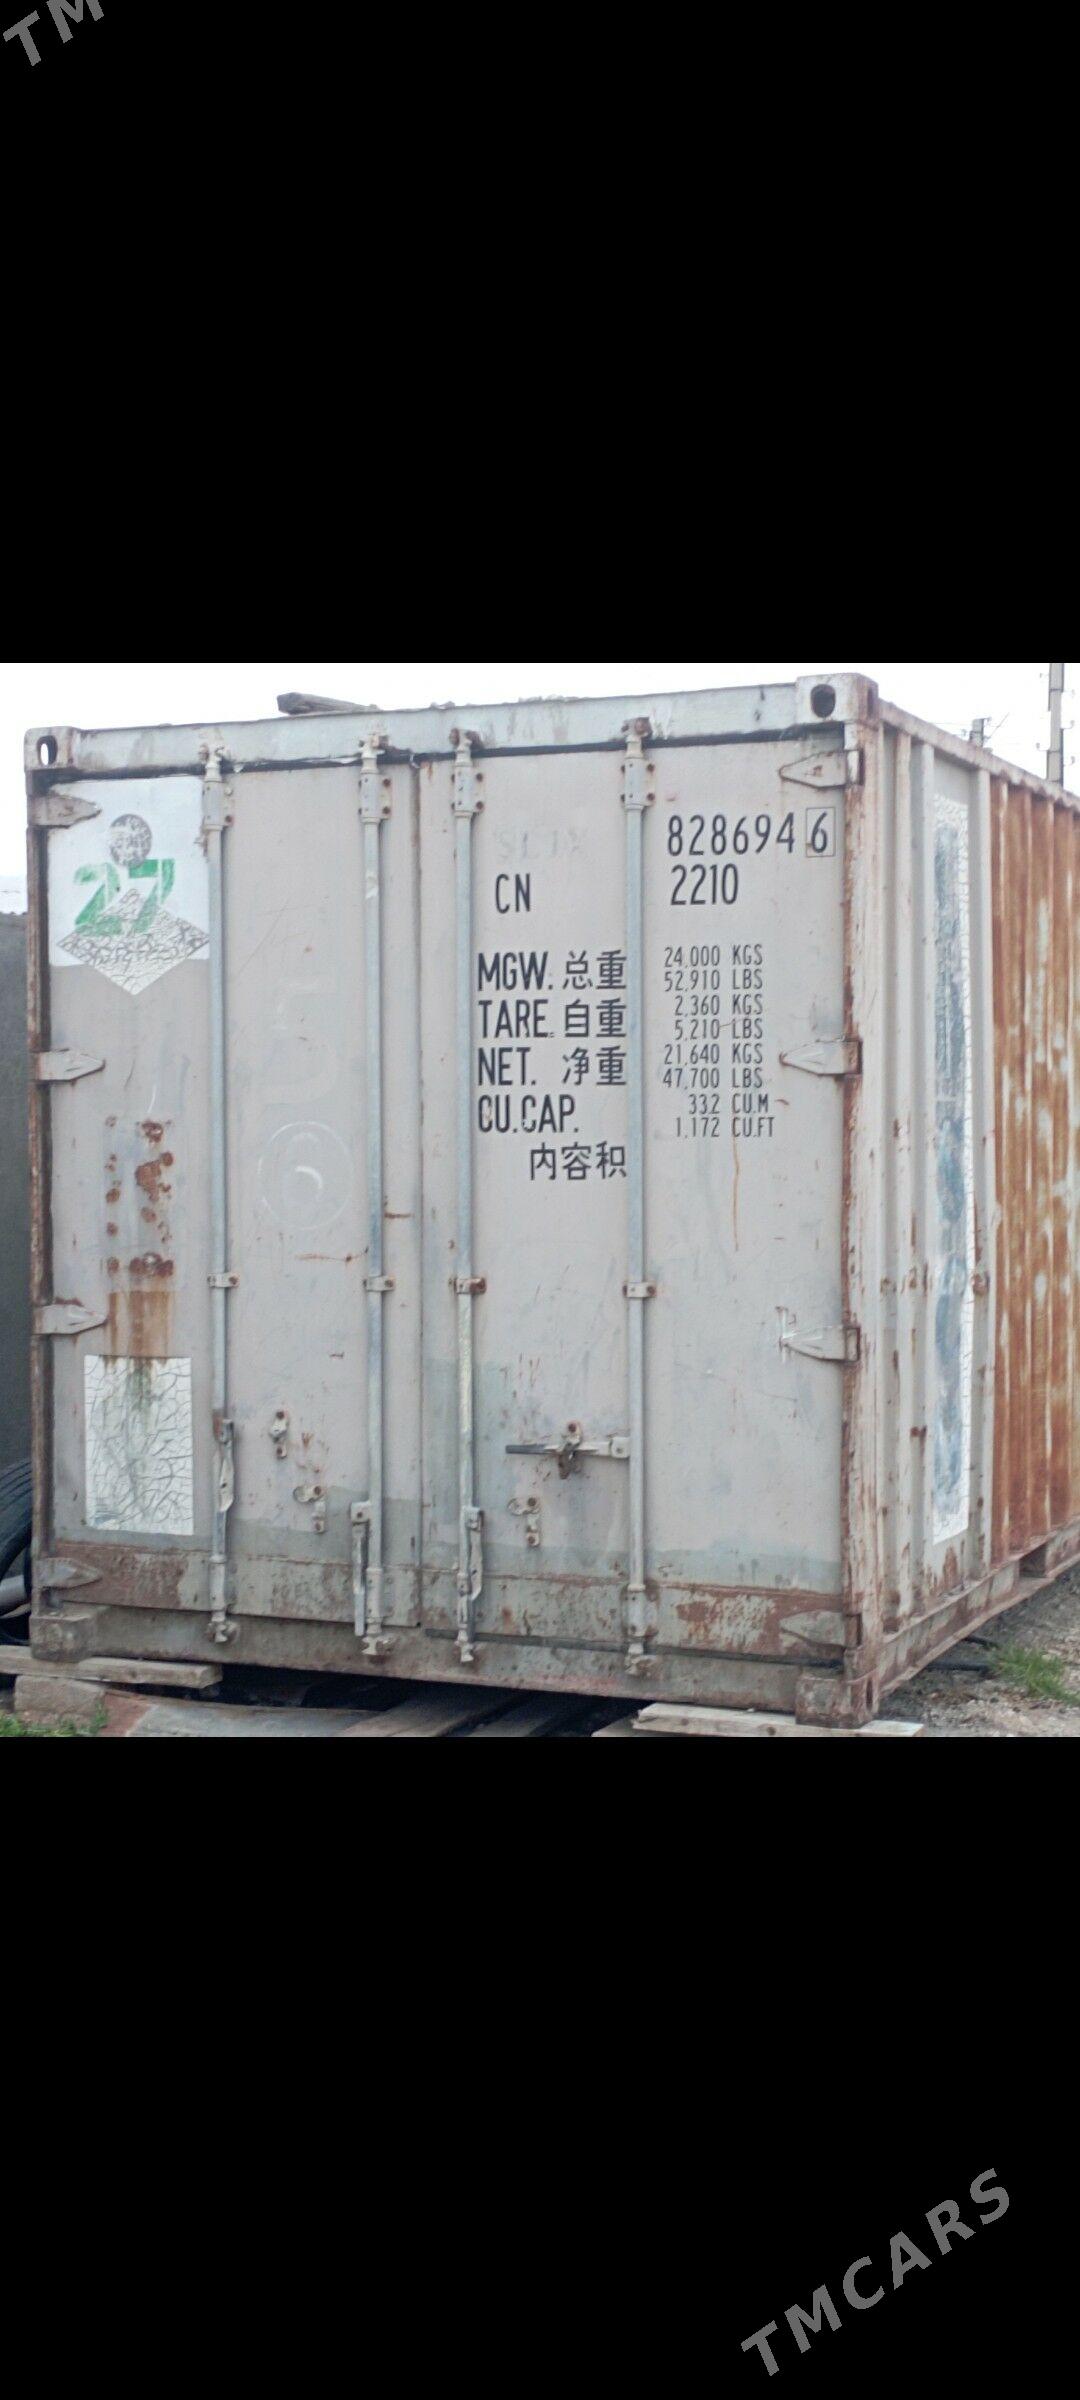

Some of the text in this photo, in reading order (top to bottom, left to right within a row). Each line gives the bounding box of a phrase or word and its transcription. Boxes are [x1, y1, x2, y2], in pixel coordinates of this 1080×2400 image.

[668, 810, 829, 857] 828694 6
[73, 858, 175, 937] 27
[495, 873, 531, 914] CN
[670, 863, 739, 906] 2210
[477, 949, 627, 992] MGW. 总重
[731, 944, 763, 966] KGS
[732, 968, 763, 990] LBS
[565, 998, 627, 1038] 自重
[731, 993, 763, 1015] KGS
[732, 1017, 763, 1040] LBS
[478, 1045, 627, 1086] NET. 净重
[731, 1042, 763, 1065] KGS
[732, 1067, 763, 1089] LBS
[478, 1094, 579, 1133] CU.CAP.
[732, 1092, 768, 1114] CU.M
[530, 1140, 627, 1181] 内容积
